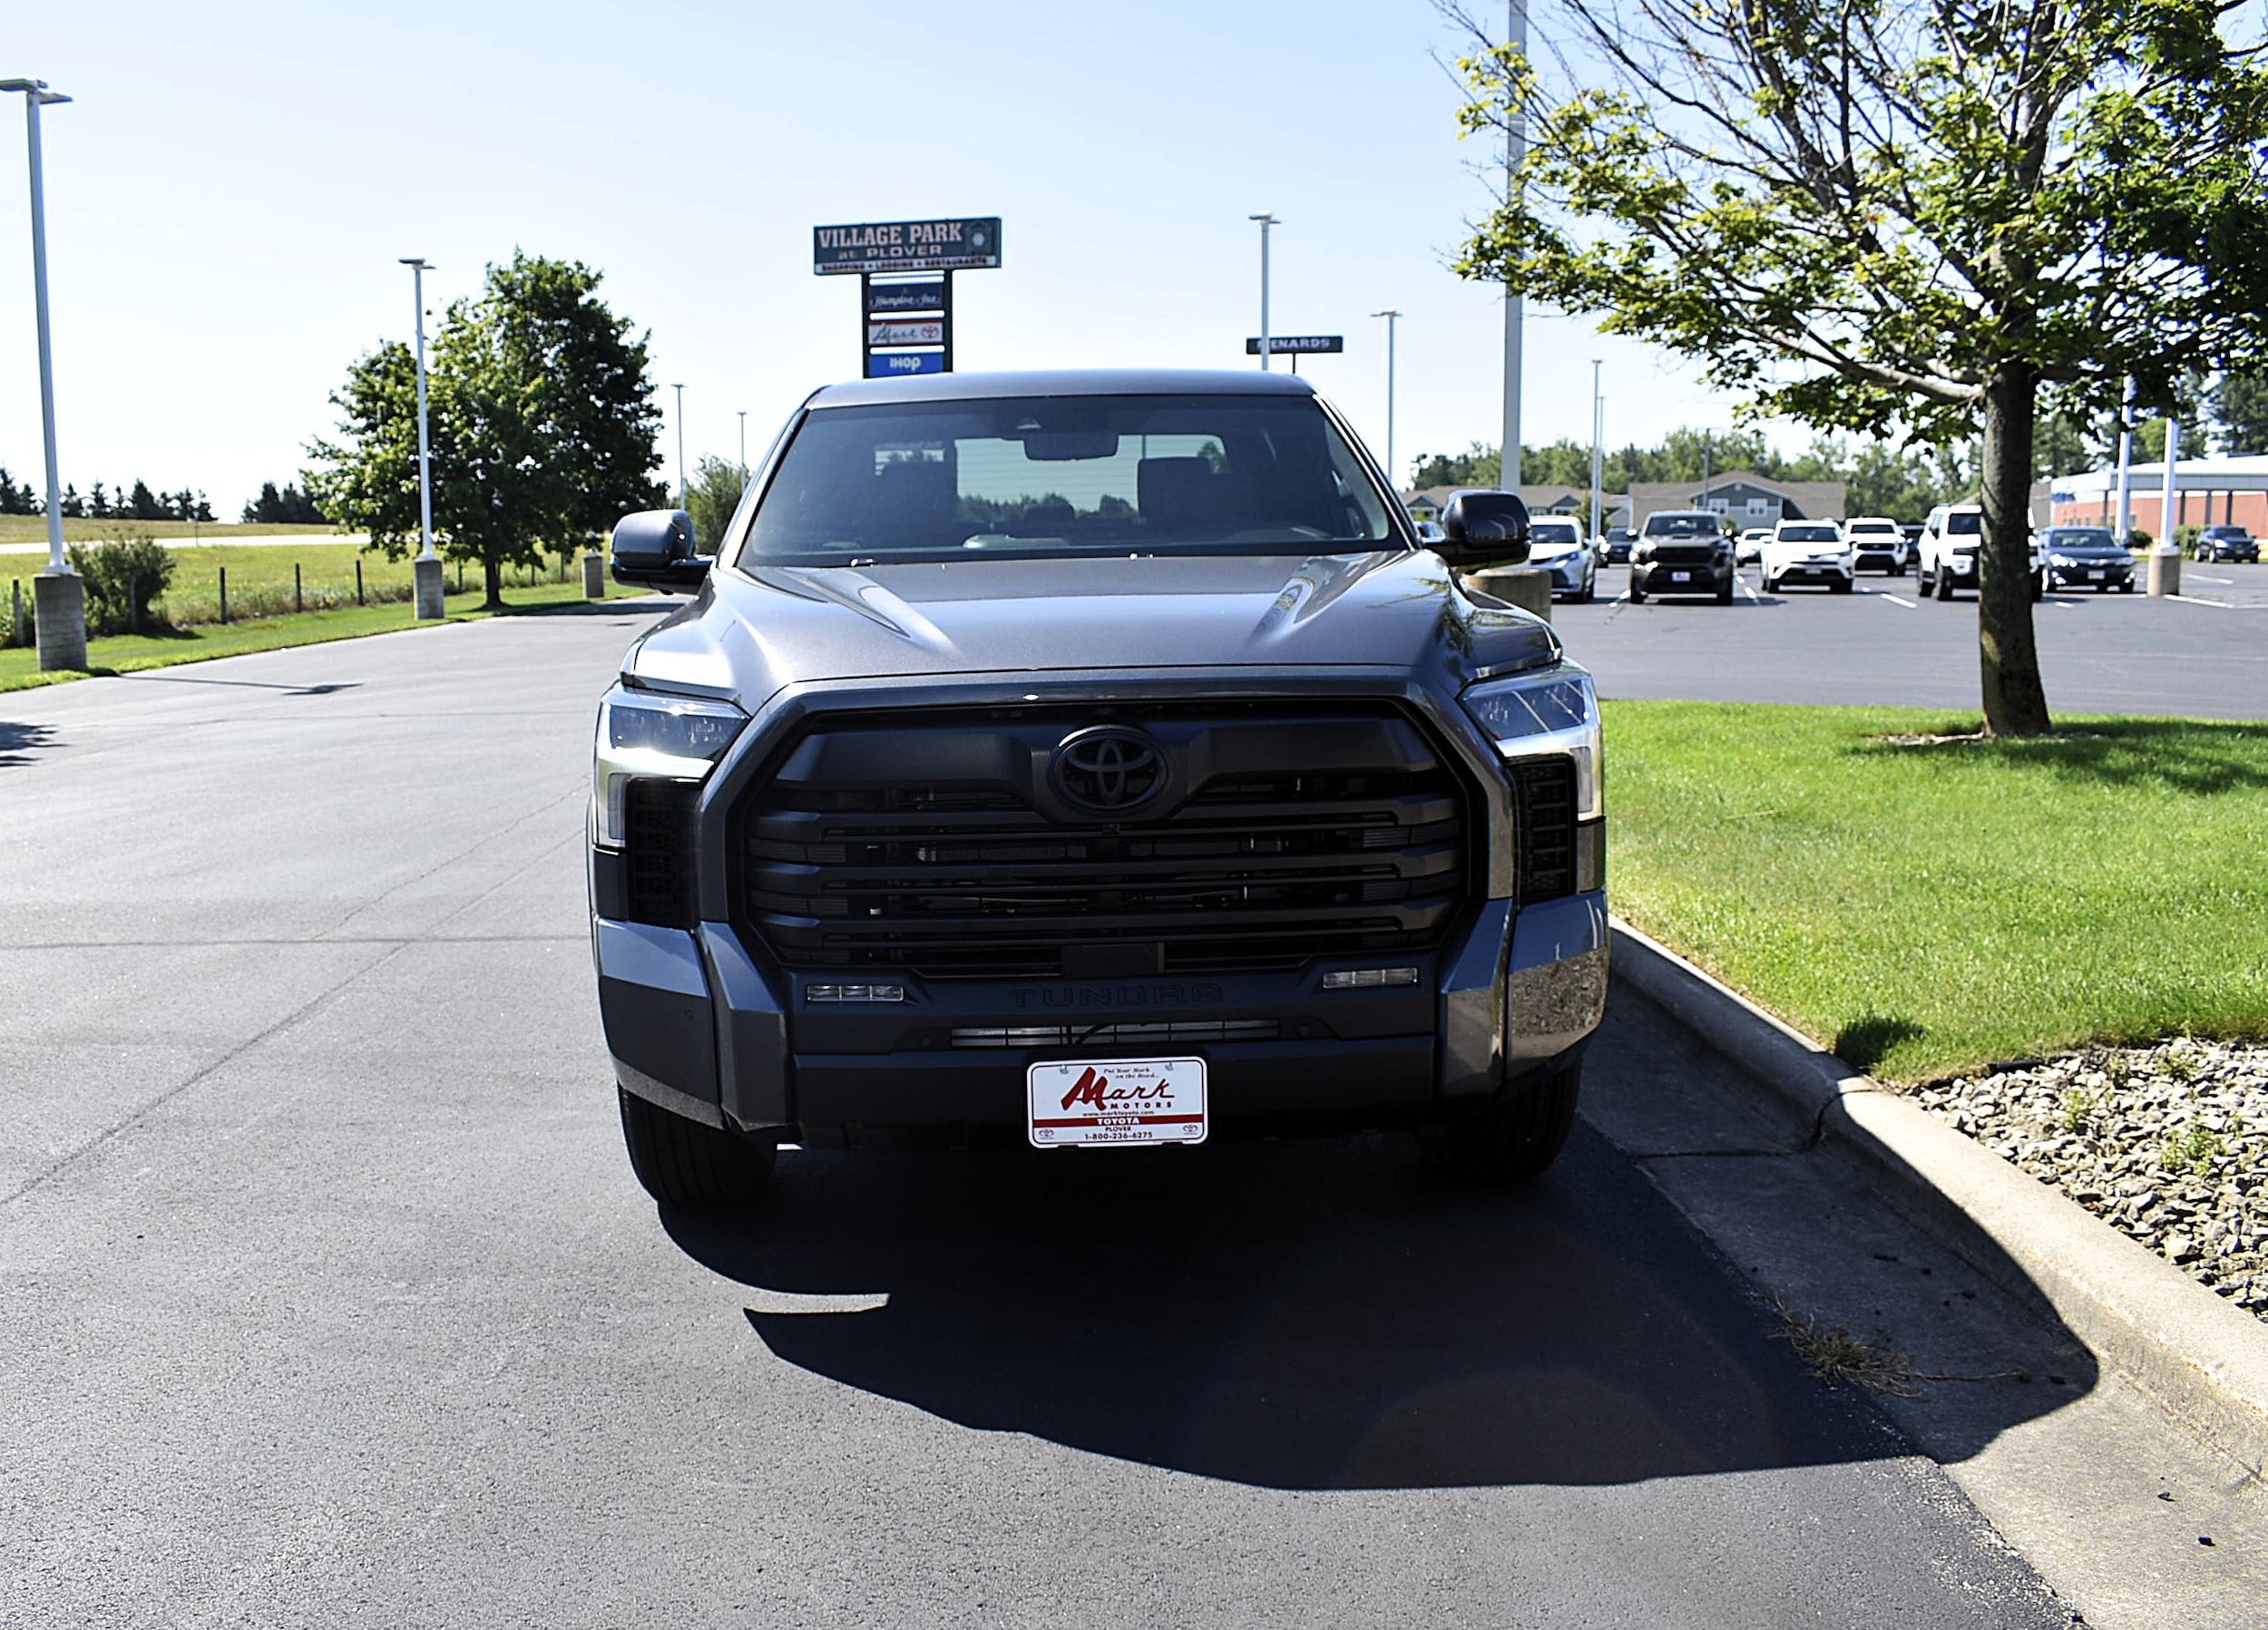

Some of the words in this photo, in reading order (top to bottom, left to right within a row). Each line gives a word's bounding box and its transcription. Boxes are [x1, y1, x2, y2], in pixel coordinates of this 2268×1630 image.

[818, 225, 903, 249] VILLAGE
[909, 222, 963, 244] PARK
[838, 250, 856, 259] at
[866, 245, 942, 258] PLOVER
[1007, 982, 1225, 1009] TUNDRA
[1061, 1066, 1175, 1111] Mark
[1110, 1101, 1173, 1109] MOTORS
[1097, 1117, 1140, 1125] TOYOTA
[1084, 1131, 1153, 1140] 1-800-236-6275
